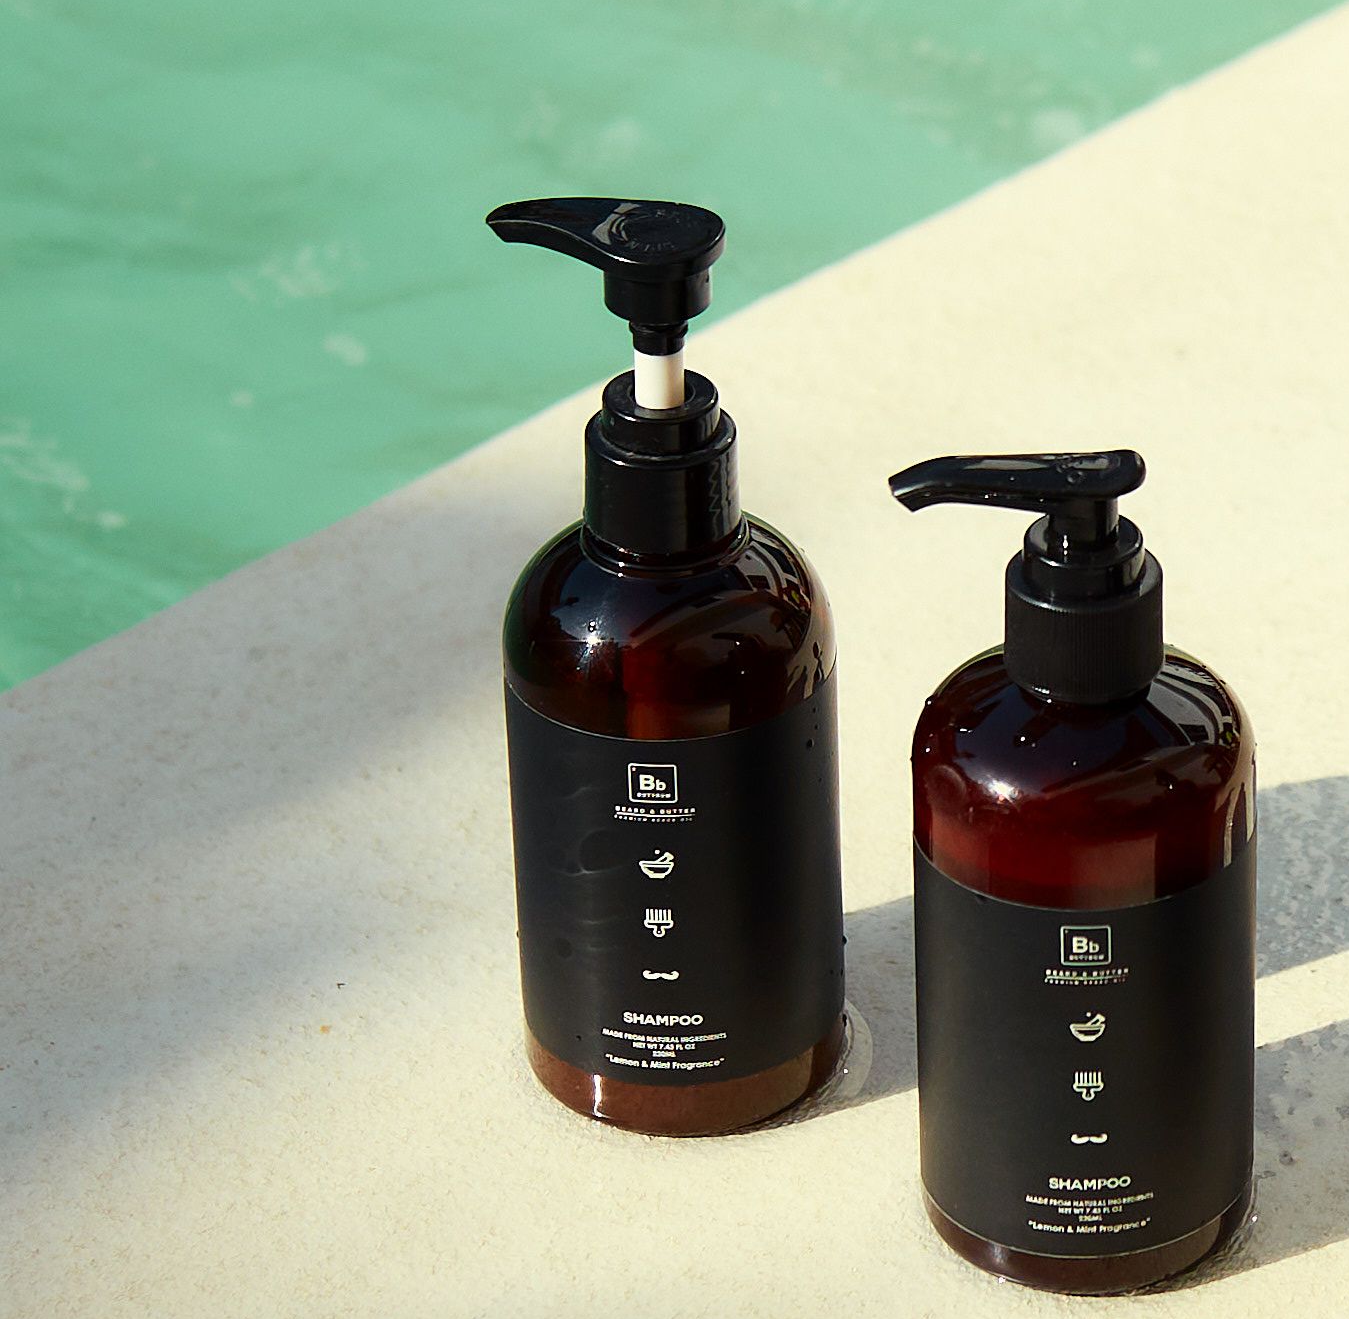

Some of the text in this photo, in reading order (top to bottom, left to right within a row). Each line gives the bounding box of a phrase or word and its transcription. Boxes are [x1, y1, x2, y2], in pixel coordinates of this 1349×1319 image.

[639, 775, 666, 790] Bb
[1072, 936, 1099, 953] Bb
[623, 1012, 703, 1026] SHAMPOO
[624, 1033, 645, 1041] FROM
[650, 1061, 670, 1069] Mint
[1049, 1176, 1131, 1191] SHAMPOO
[1076, 1225, 1096, 1233] Mint
